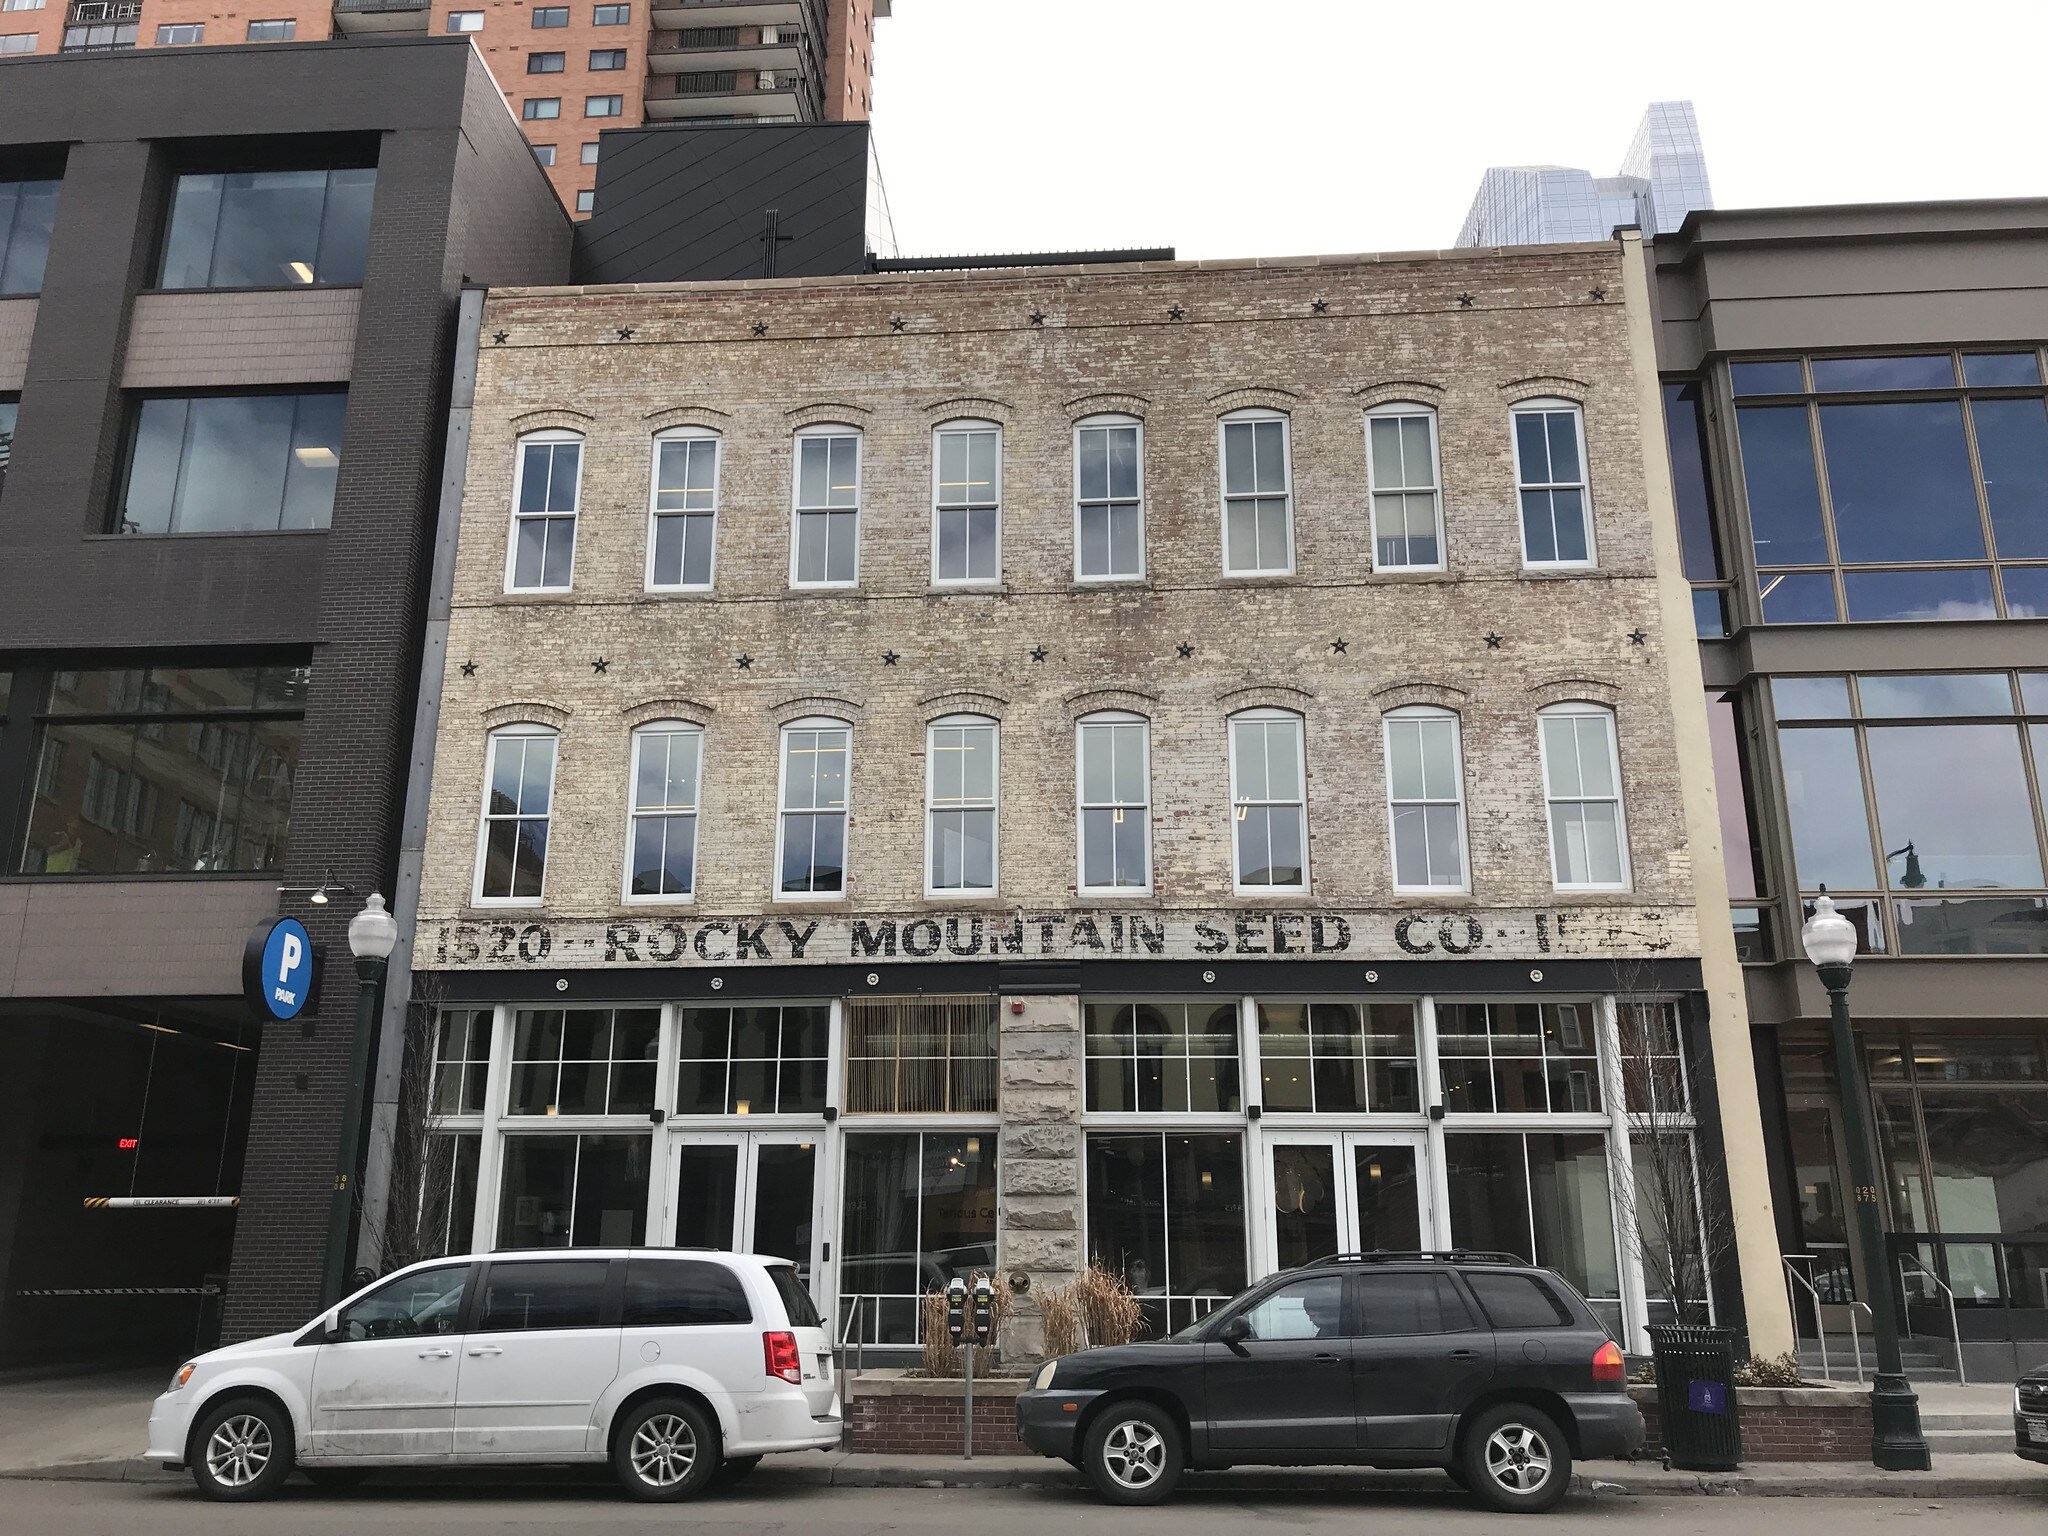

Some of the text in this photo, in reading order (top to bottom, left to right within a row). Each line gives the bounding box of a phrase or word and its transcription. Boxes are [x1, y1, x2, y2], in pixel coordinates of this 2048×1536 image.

[437, 924, 552, 964] 1520
[604, 920, 817, 963] ROCKY
[852, 914, 1164, 960] MOUNTAIN
[1194, 914, 1351, 955] SEED
[279, 932, 302, 983] P
[274, 986, 296, 1006] PARK
[119, 1138, 138, 1149] EXIT
[1855, 1185, 1875, 1194] 020
[1856, 1194, 1877, 1202] 875
